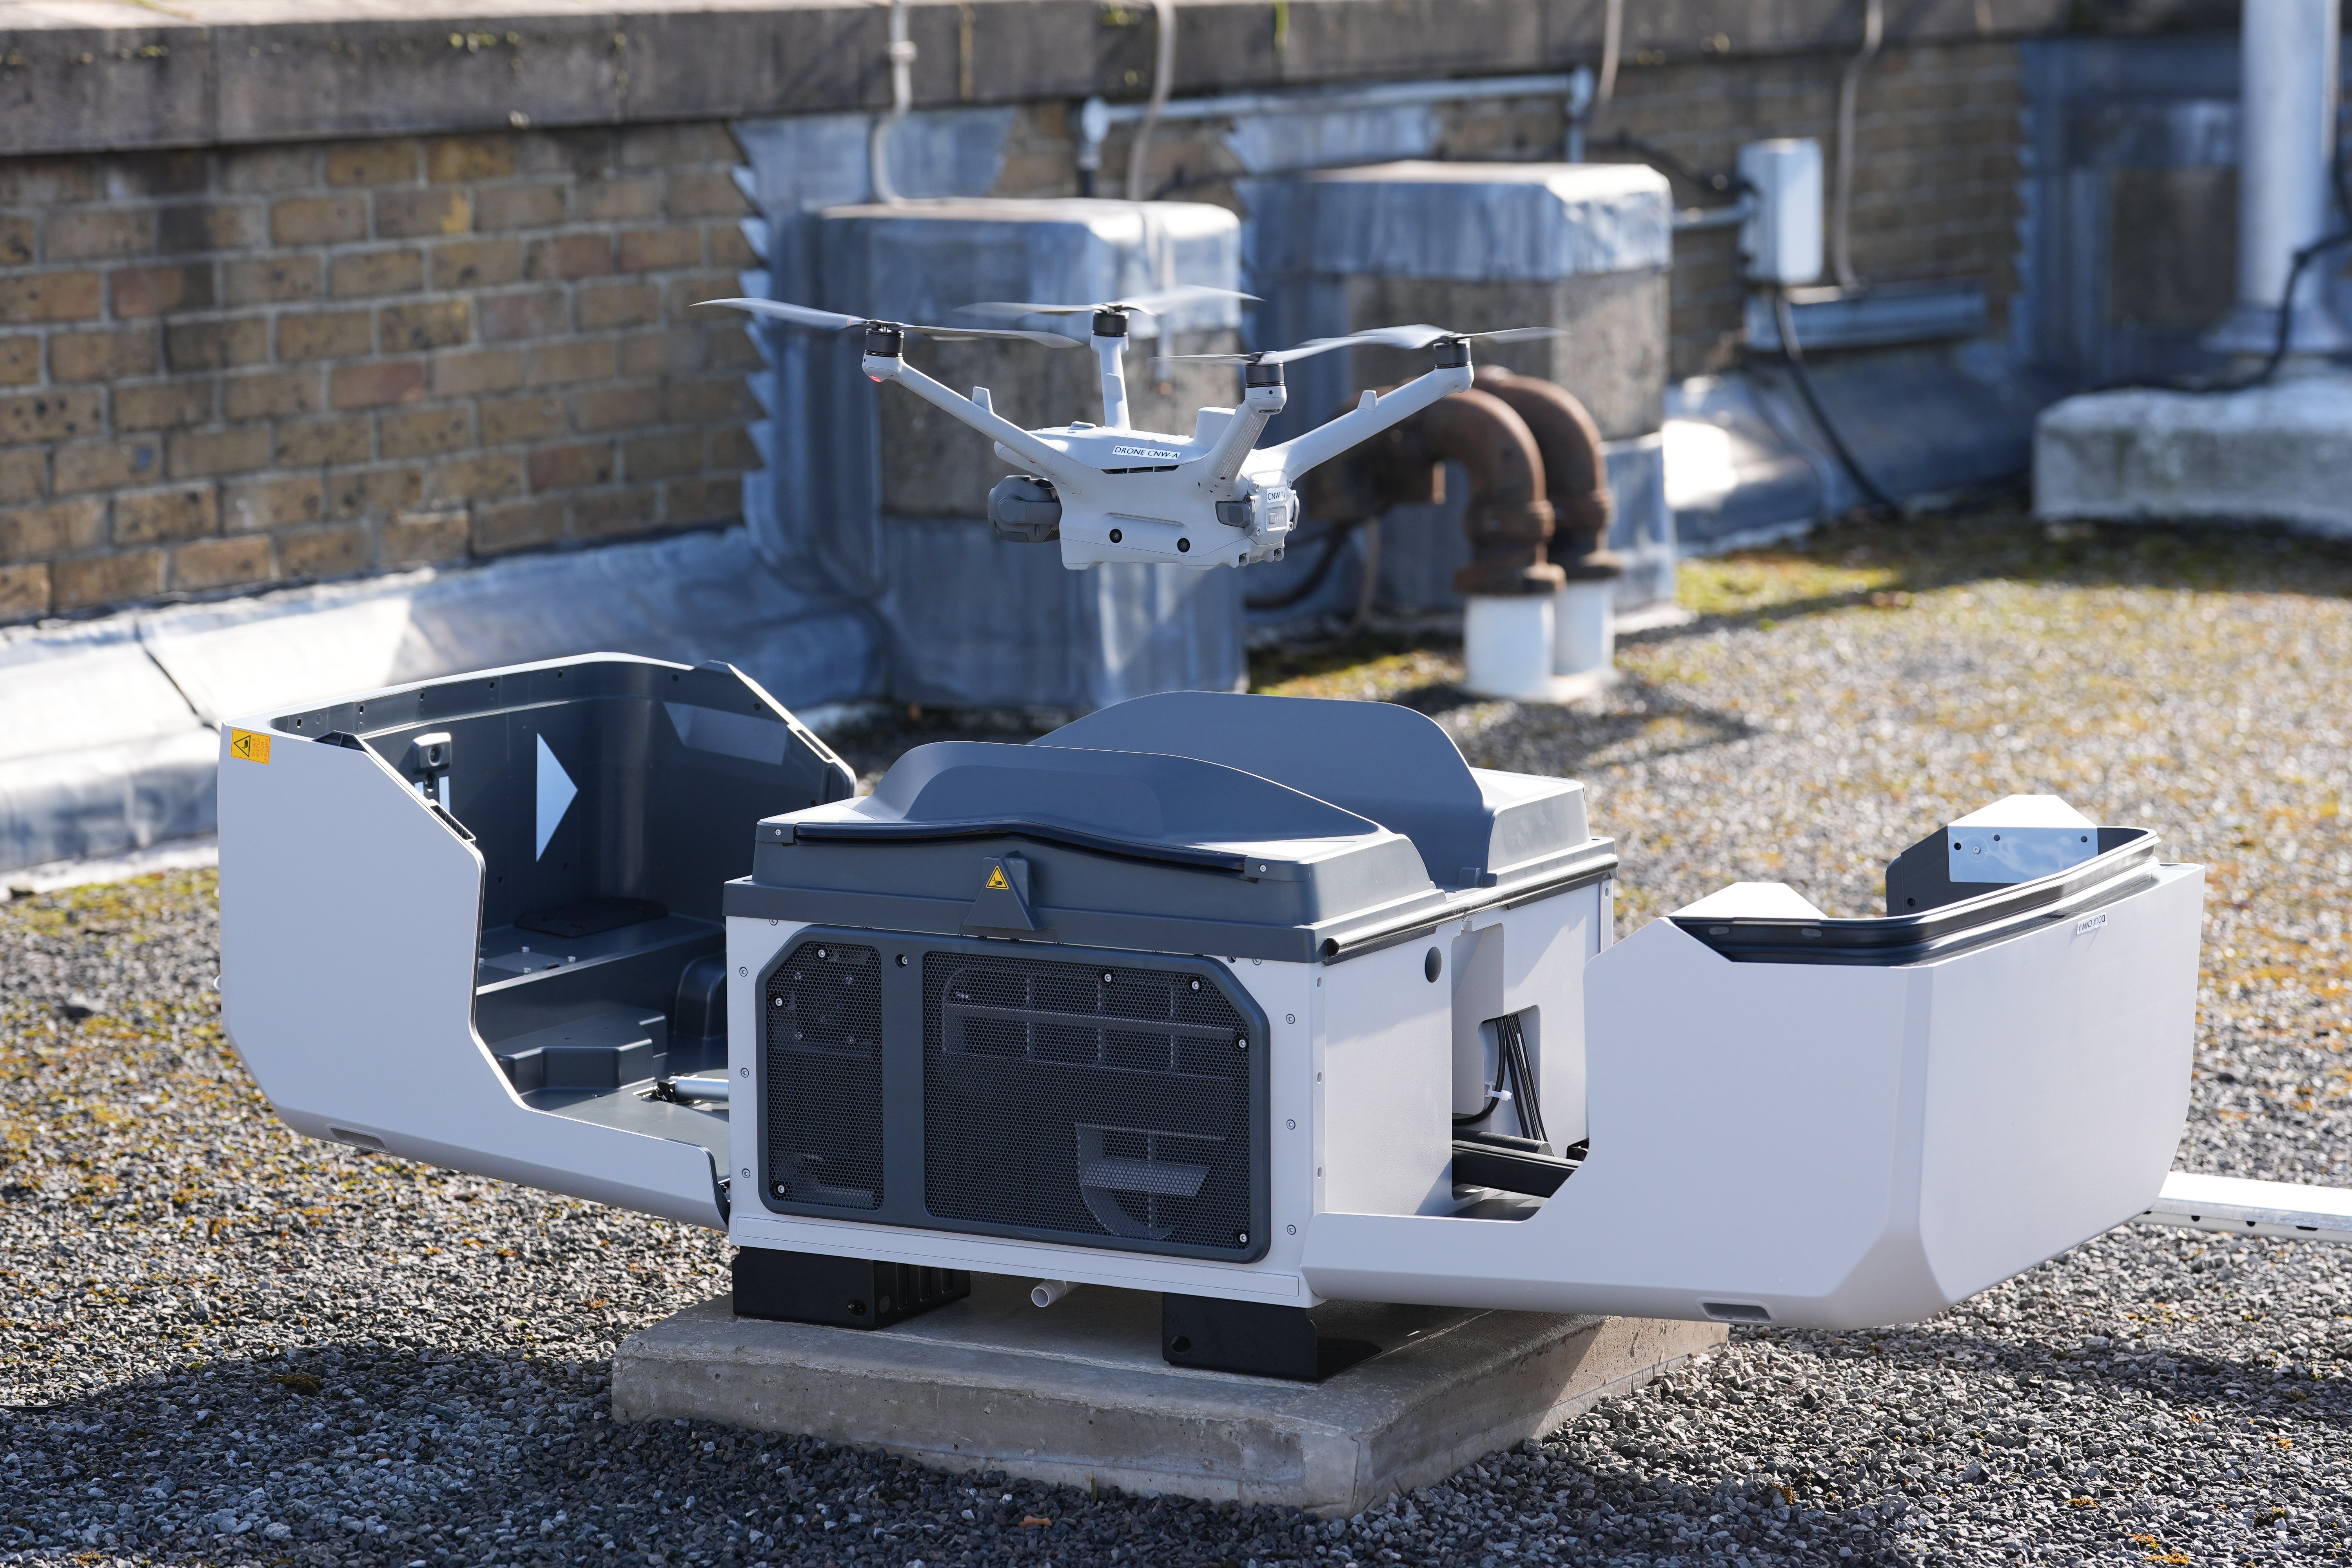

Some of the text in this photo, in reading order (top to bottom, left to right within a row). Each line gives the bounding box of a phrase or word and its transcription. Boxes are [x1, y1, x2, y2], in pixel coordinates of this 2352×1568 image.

[1114, 447, 1145, 455] DRONE
[2078, 915, 2105, 932] DOCK CNW-A
